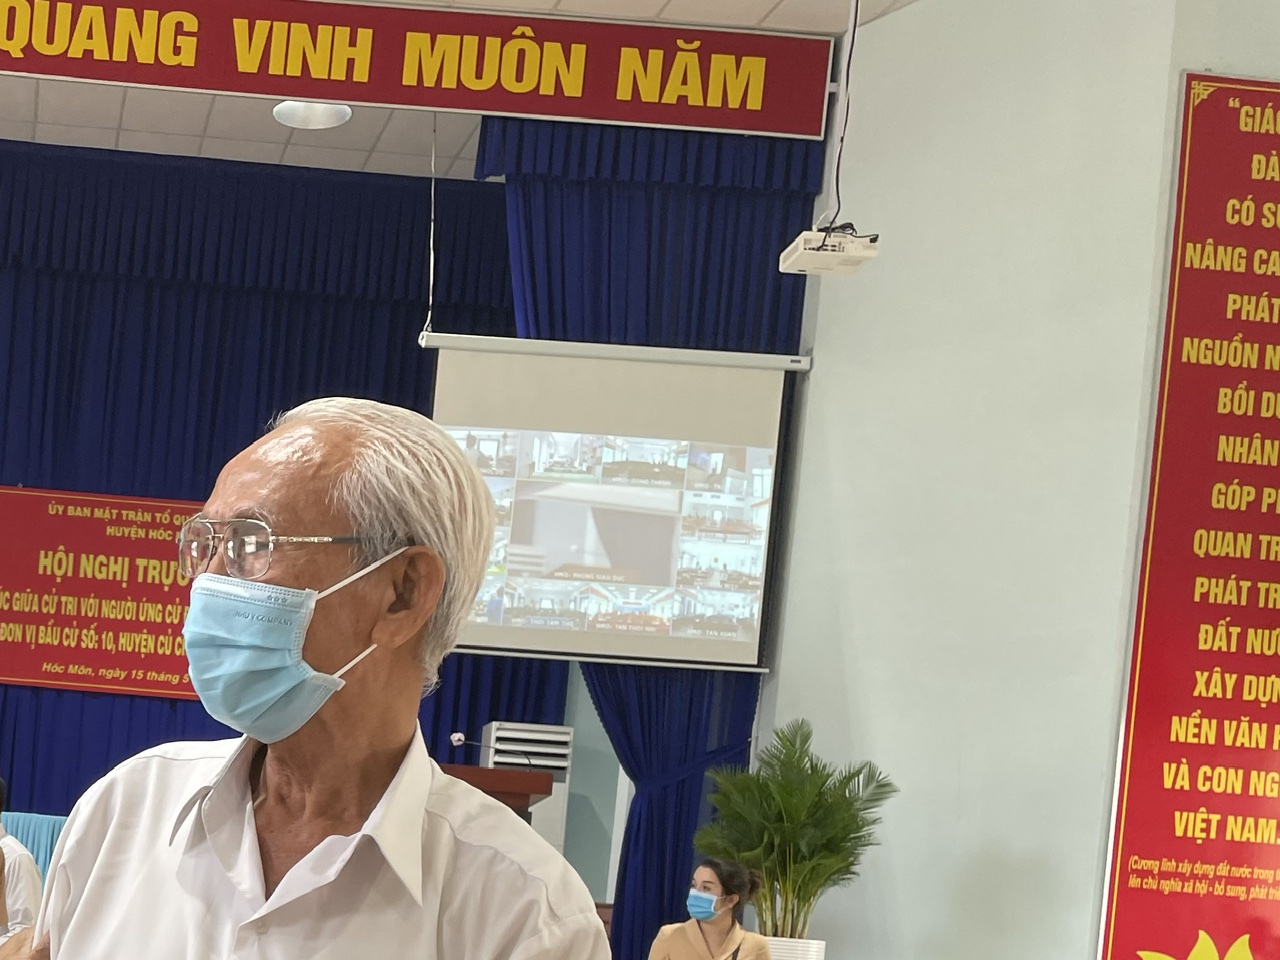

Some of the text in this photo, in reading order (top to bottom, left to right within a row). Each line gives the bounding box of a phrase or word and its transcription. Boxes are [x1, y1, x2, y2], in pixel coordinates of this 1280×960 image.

[233, 18, 373, 82] VINH
[402, 26, 587, 97] MUÔN
[616, 39, 766, 110] NĂM
[1225, 194, 1255, 226] CÓ
[1184, 238, 1247, 273] NÂNG
[1226, 291, 1280, 324] PHÁT
[1181, 332, 1260, 369] NGUỒN
[1217, 380, 1280, 419] BỒI D
[1217, 432, 1280, 466] NHÂN
[67, 505, 91, 517] BAN
[1211, 479, 1256, 511] GÓP
[106, 524, 145, 541] HUYỆN
[148, 527, 173, 540] HÓC
[1193, 528, 1253, 559] QUAN
[38, 545, 74, 583] HỘI
[79, 553, 130, 589] NGHỊ
[61, 595, 78, 616] TRI
[80, 592, 99, 618] VỚI
[101, 595, 137, 620] NGƯỜI
[1193, 574, 1252, 606] PHÁT
[25, 624, 37, 650] VỊ
[81, 622, 99, 649] SỐ:
[101, 630, 116, 655] 10,
[118, 628, 155, 659] HUYỆN
[1198, 616, 1280, 656] ĐẤT NƯ
[42, 662, 66, 673] Hóc
[98, 667, 128, 680] ngày
[131, 670, 144, 680] 15
[146, 670, 180, 685] tháng
[1193, 666, 1238, 699] XÂY
[1170, 709, 1218, 746] NỀN
[1224, 715, 1268, 749] VĂN
[1163, 758, 1190, 791] VÀ
[1197, 765, 1244, 795] CON
[1174, 807, 1221, 844] VIỆT
